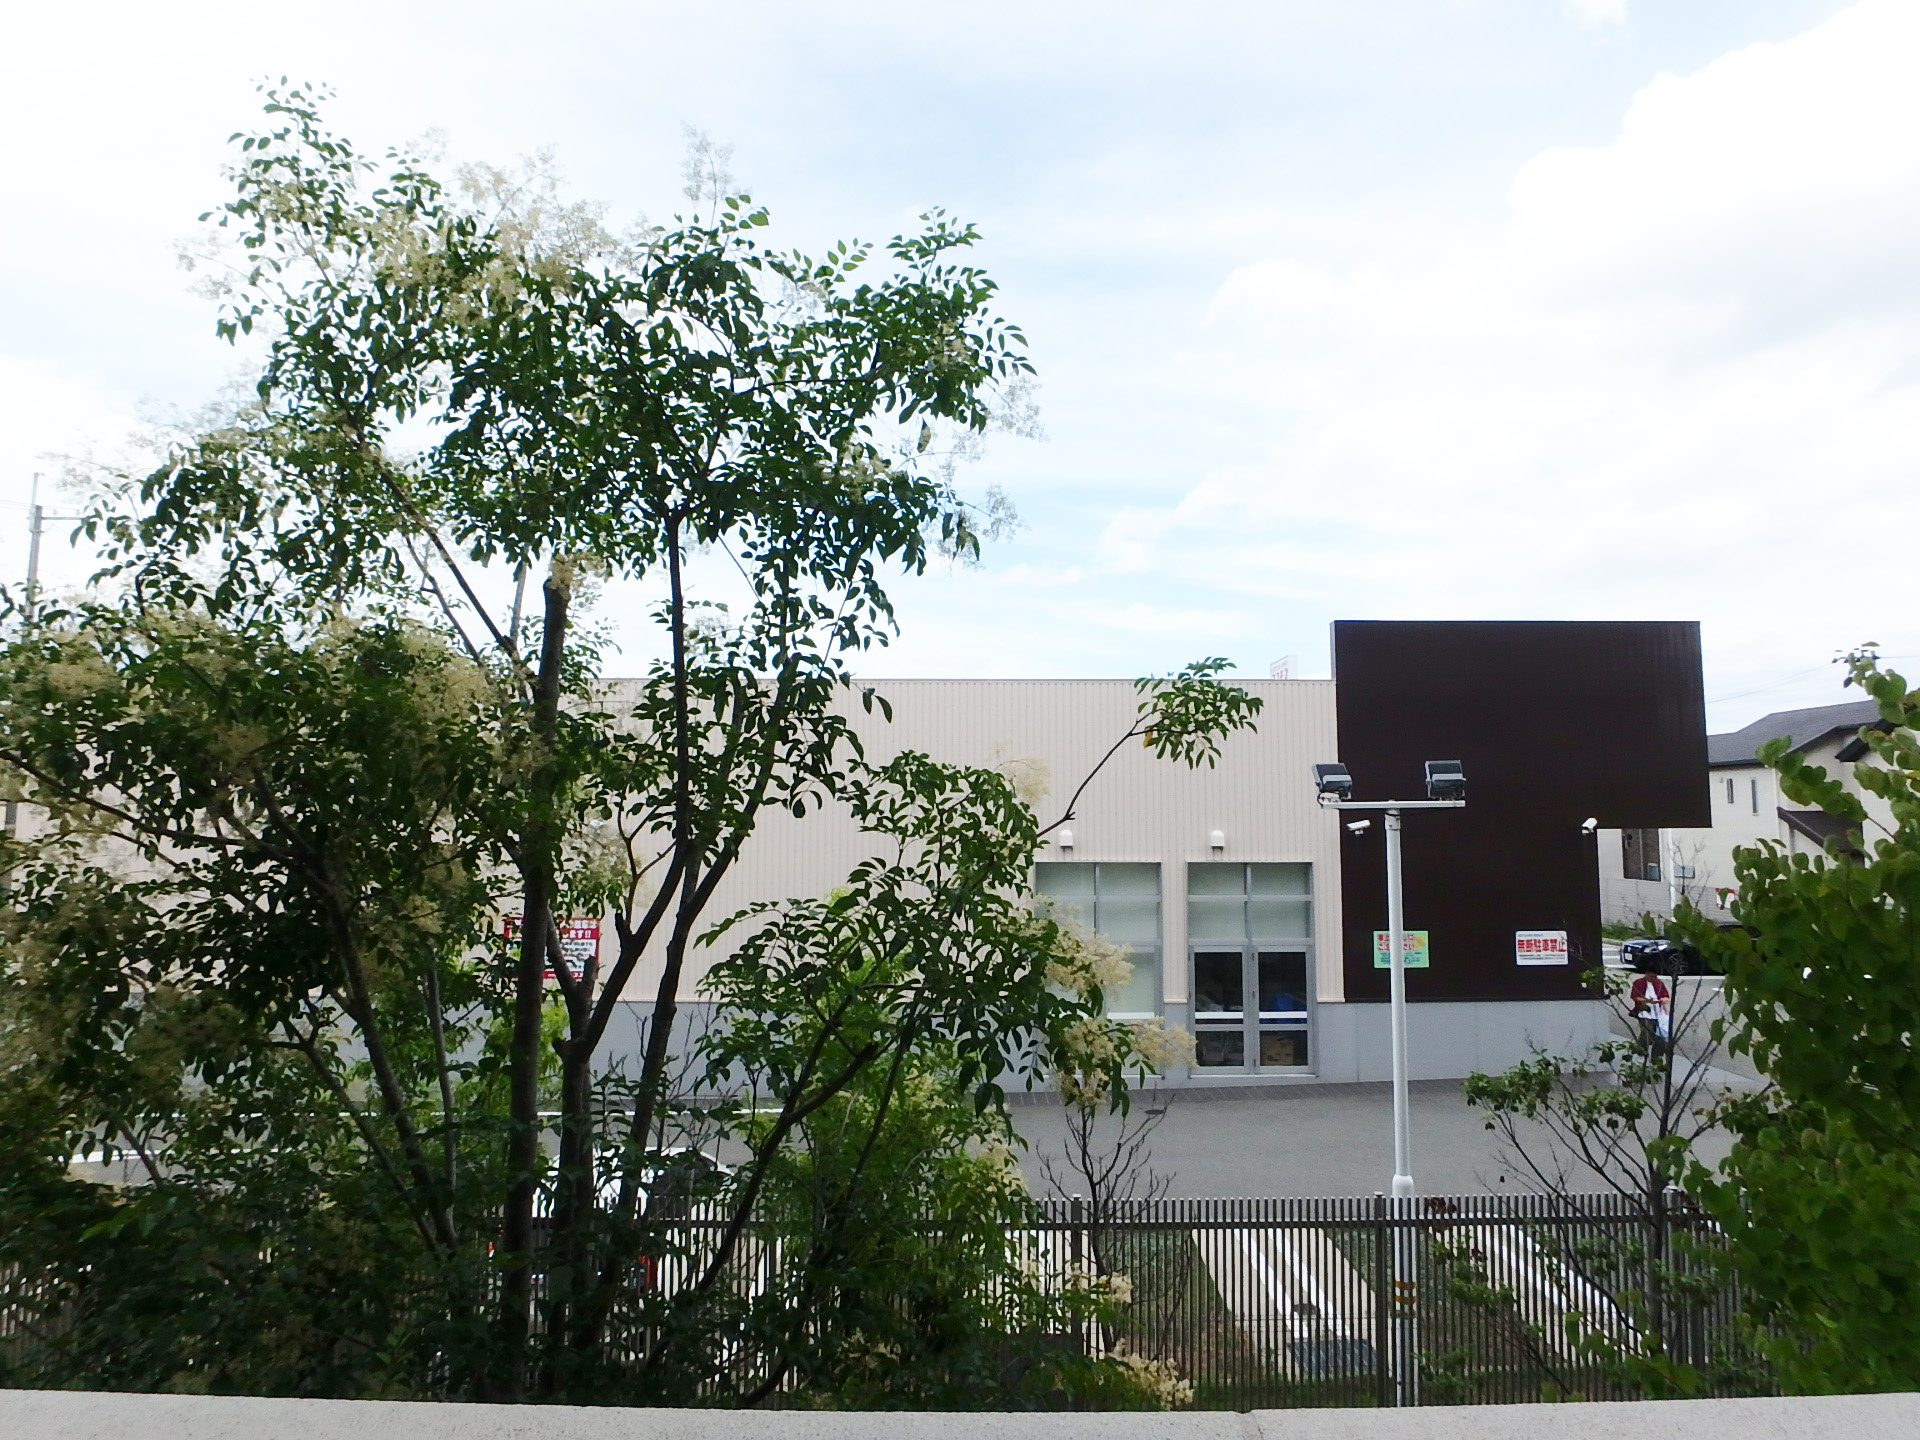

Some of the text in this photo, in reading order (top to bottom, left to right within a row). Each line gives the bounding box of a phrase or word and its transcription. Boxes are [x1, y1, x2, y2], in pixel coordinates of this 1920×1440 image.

[1517, 938, 1567, 953] 無断駐車禁止
